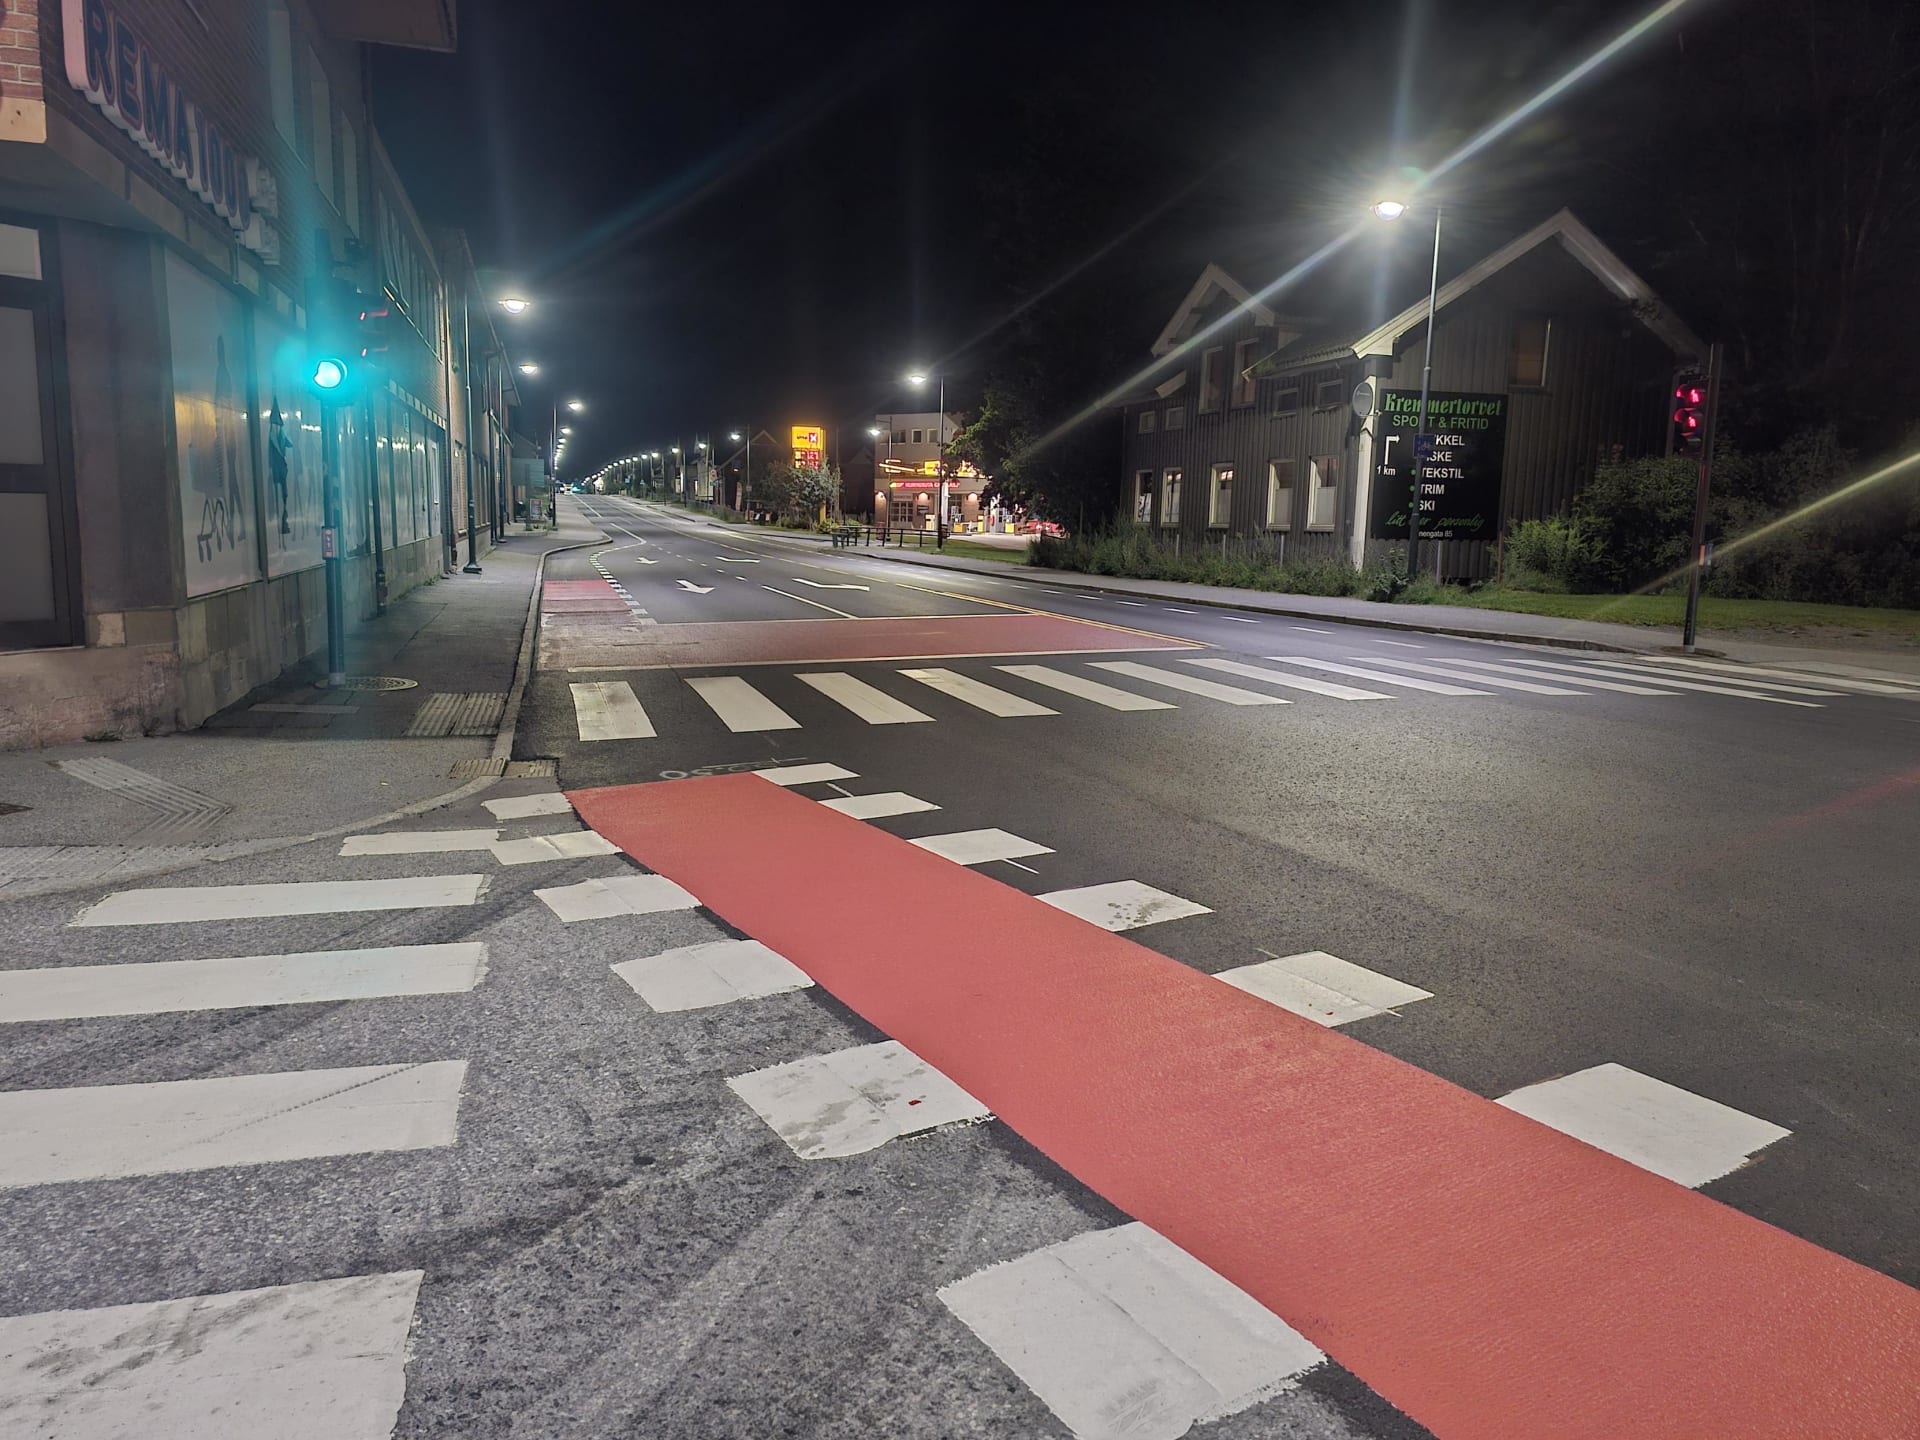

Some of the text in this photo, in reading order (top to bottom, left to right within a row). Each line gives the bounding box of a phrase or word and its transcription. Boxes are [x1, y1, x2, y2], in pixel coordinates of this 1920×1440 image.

[83, 0, 194, 180] REMA
[1392, 415, 1489, 430] SPOT & FRITID
[1434, 434, 1465, 446] KKEL
[1427, 451, 1452, 462] SKE
[1376, 465, 1396, 476] 1 km
[1421, 467, 1464, 479] TEKSTIL
[1420, 484, 1445, 495] TRIM
[1419, 500, 1436, 511] SKI
